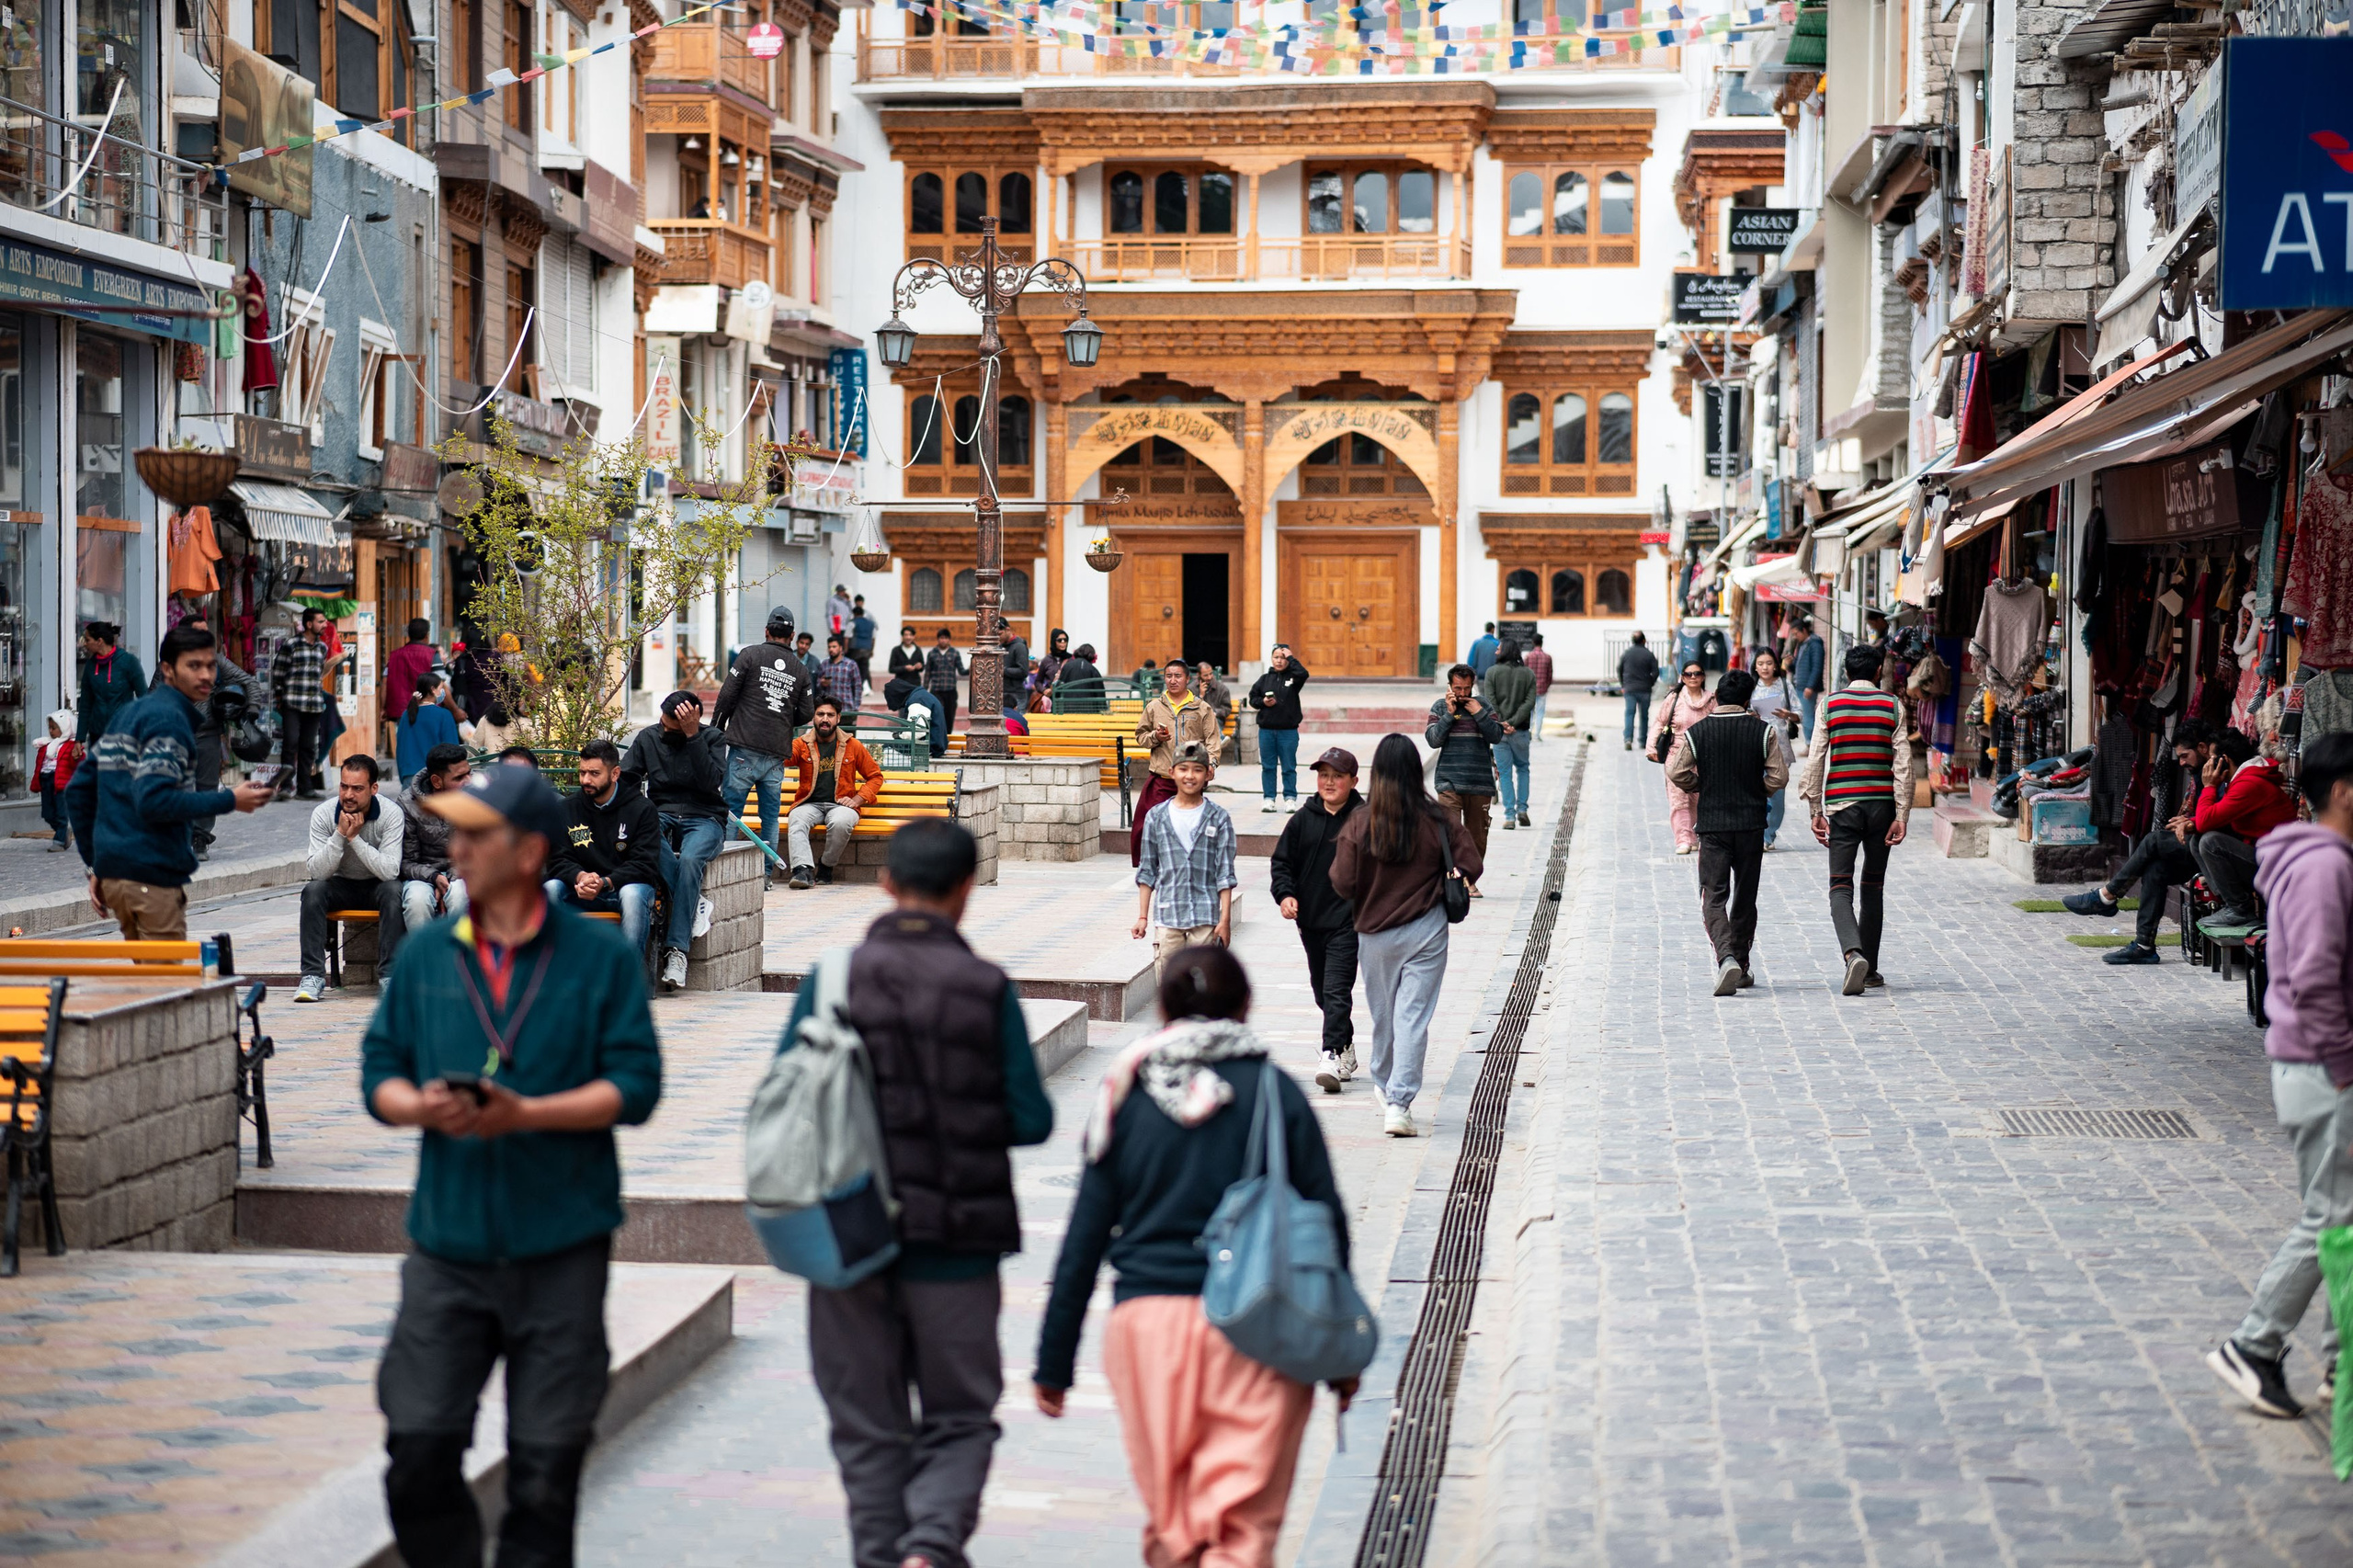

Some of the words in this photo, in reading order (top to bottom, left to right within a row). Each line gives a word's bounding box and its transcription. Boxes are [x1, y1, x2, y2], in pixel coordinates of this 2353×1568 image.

[1737, 215, 1794, 229] ASIAN
[1732, 232, 1791, 245] CORNER
[8, 247, 32, 275] ARTS
[35, 254, 84, 288] EMPORIUM
[93, 268, 142, 302] EVERGREEN
[145, 282, 165, 308] ARTS
[167, 288, 208, 312] EMPORIUM
[1685, 295, 1729, 303] RESTAURAN
[655, 376, 671, 441] BRAZIL
[1095, 506, 1130, 519] Jamia
